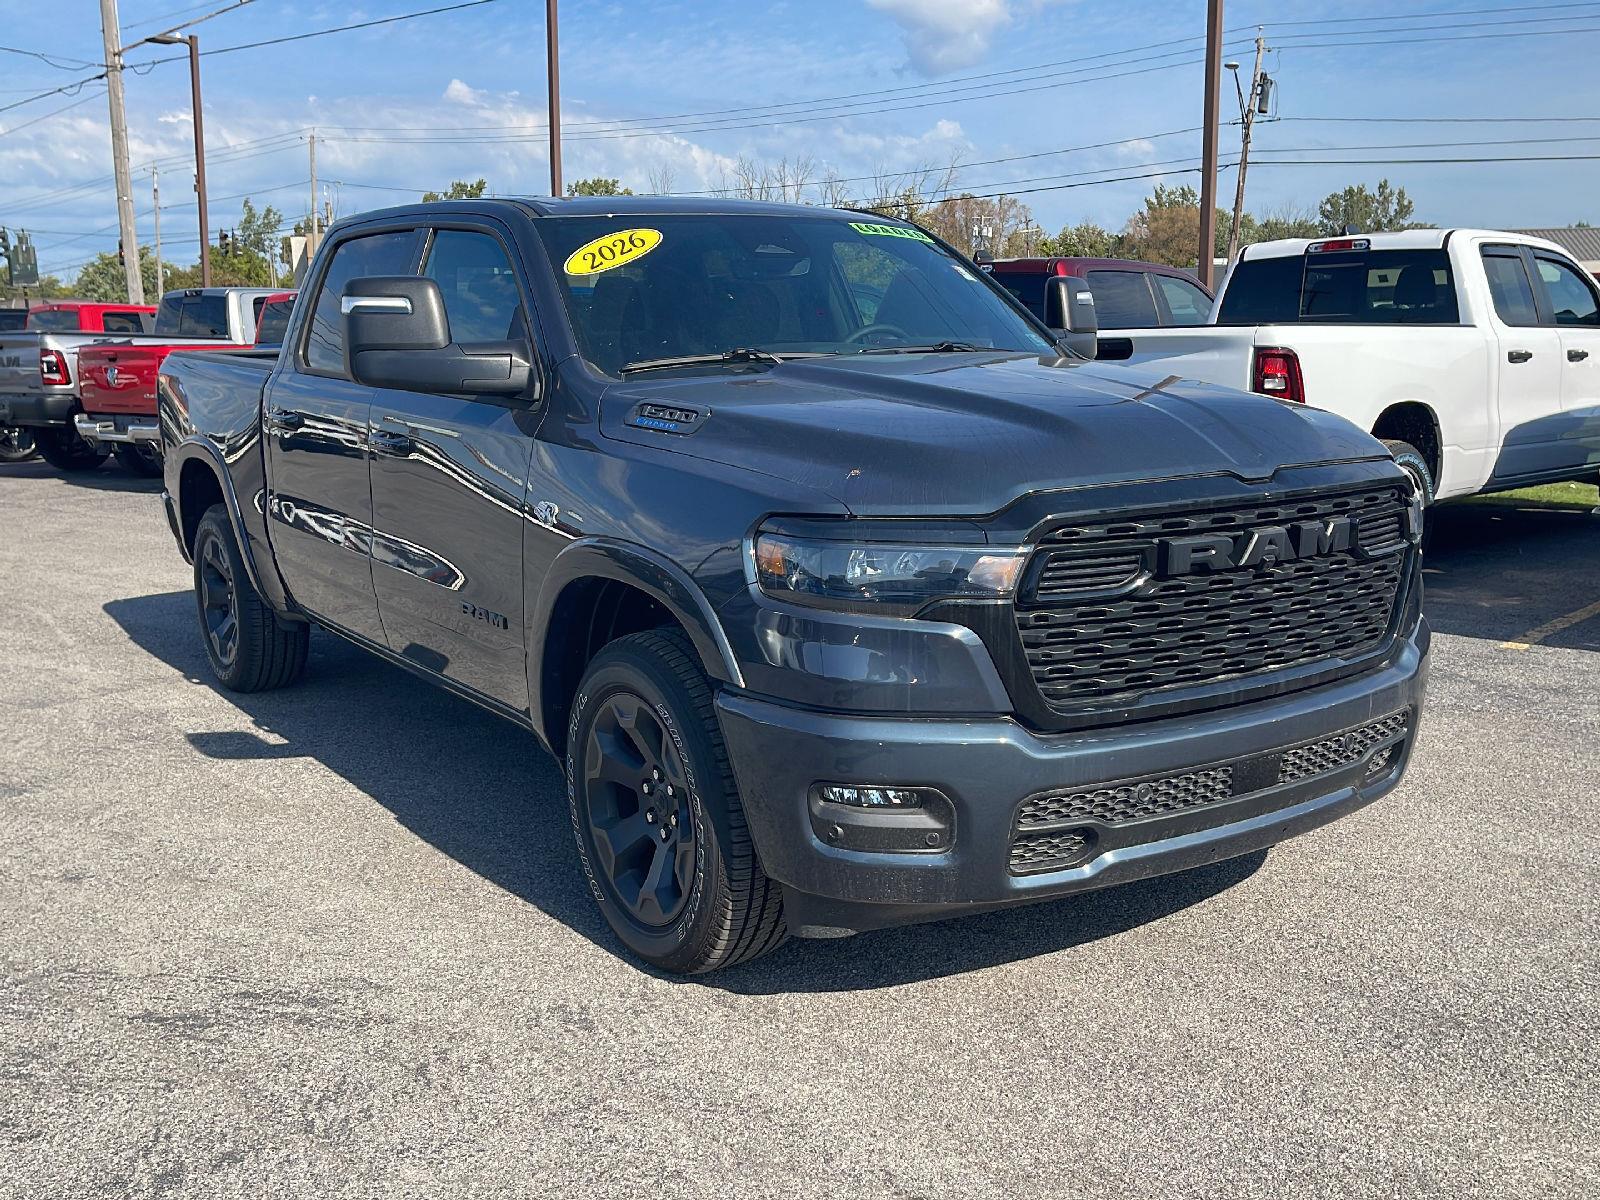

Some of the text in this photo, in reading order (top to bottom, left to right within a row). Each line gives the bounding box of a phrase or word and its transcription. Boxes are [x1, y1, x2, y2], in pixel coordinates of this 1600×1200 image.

[582, 231, 646, 270] 2026
[1157, 515, 1359, 576] RAM
[460, 600, 509, 630] RAM
[655, 703, 705, 942] BRIDGESTONE
